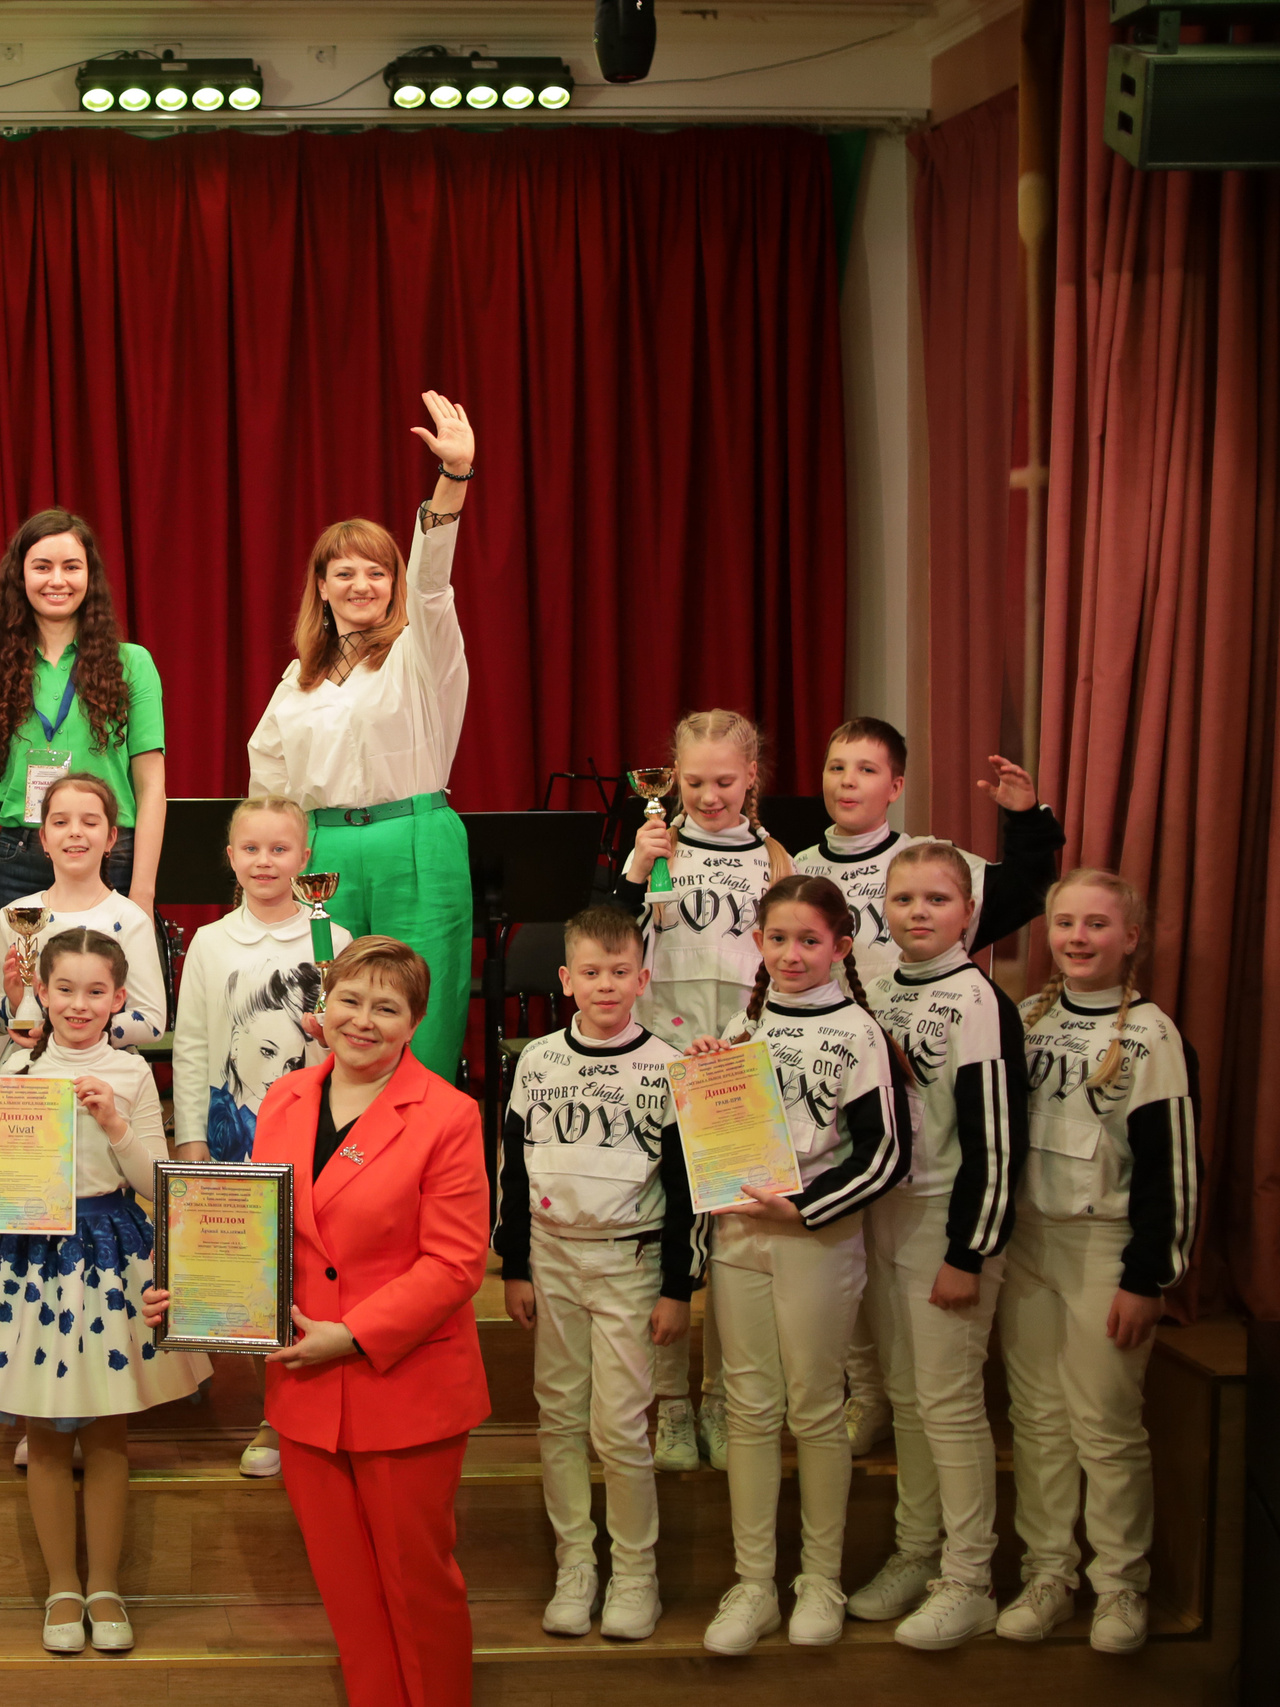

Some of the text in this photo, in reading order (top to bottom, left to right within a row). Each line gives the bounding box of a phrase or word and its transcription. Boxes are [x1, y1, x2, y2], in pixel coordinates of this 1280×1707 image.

[674, 850, 694, 858] RLS
[804, 866, 832, 876] GIRLS
[672, 874, 704, 888] PORT
[930, 990, 962, 1001] SUPPORT
[818, 1026, 856, 1040] SUPPORT
[1024, 1034, 1054, 1046] PORT
[543, 1050, 572, 1066] GIRLS
[632, 1062, 665, 1071] SUPPOR
[640, 1076, 669, 1092] DAN
[526, 1086, 578, 1101] SUPPORT
[704, 1083, 746, 1100] Диплом
[0, 1112, 42, 1122] Диплом
[8, 1124, 34, 1134] Vivat
[200, 1214, 245, 1224] Диплом
